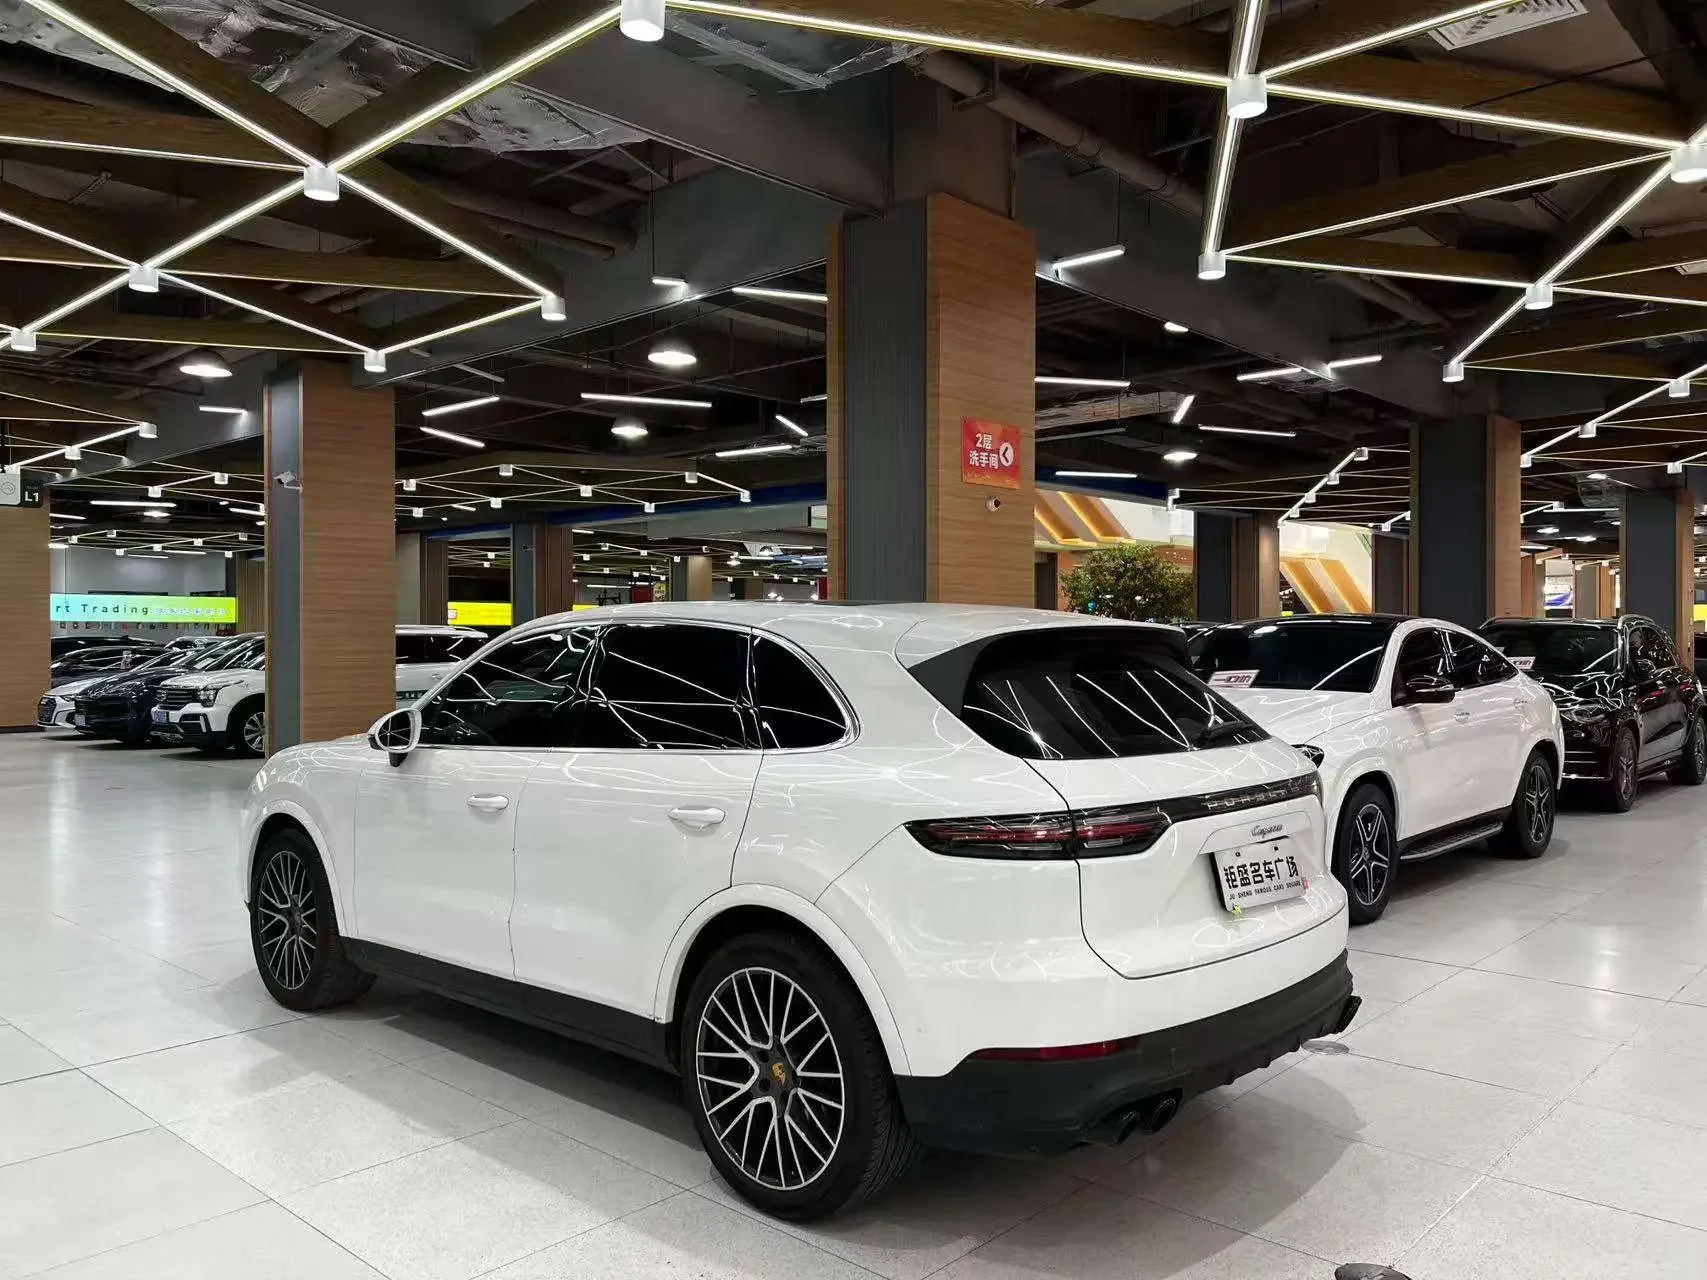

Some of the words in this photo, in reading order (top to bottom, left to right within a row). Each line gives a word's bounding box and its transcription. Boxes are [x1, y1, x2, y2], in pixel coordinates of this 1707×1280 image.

[976, 433, 992, 449] 2层
[969, 450, 999, 469] 洗手间
[25, 491, 39, 502] L1
[81, 603, 149, 616] Trading
[1223, 856, 1299, 889] 钜盛名车广场
